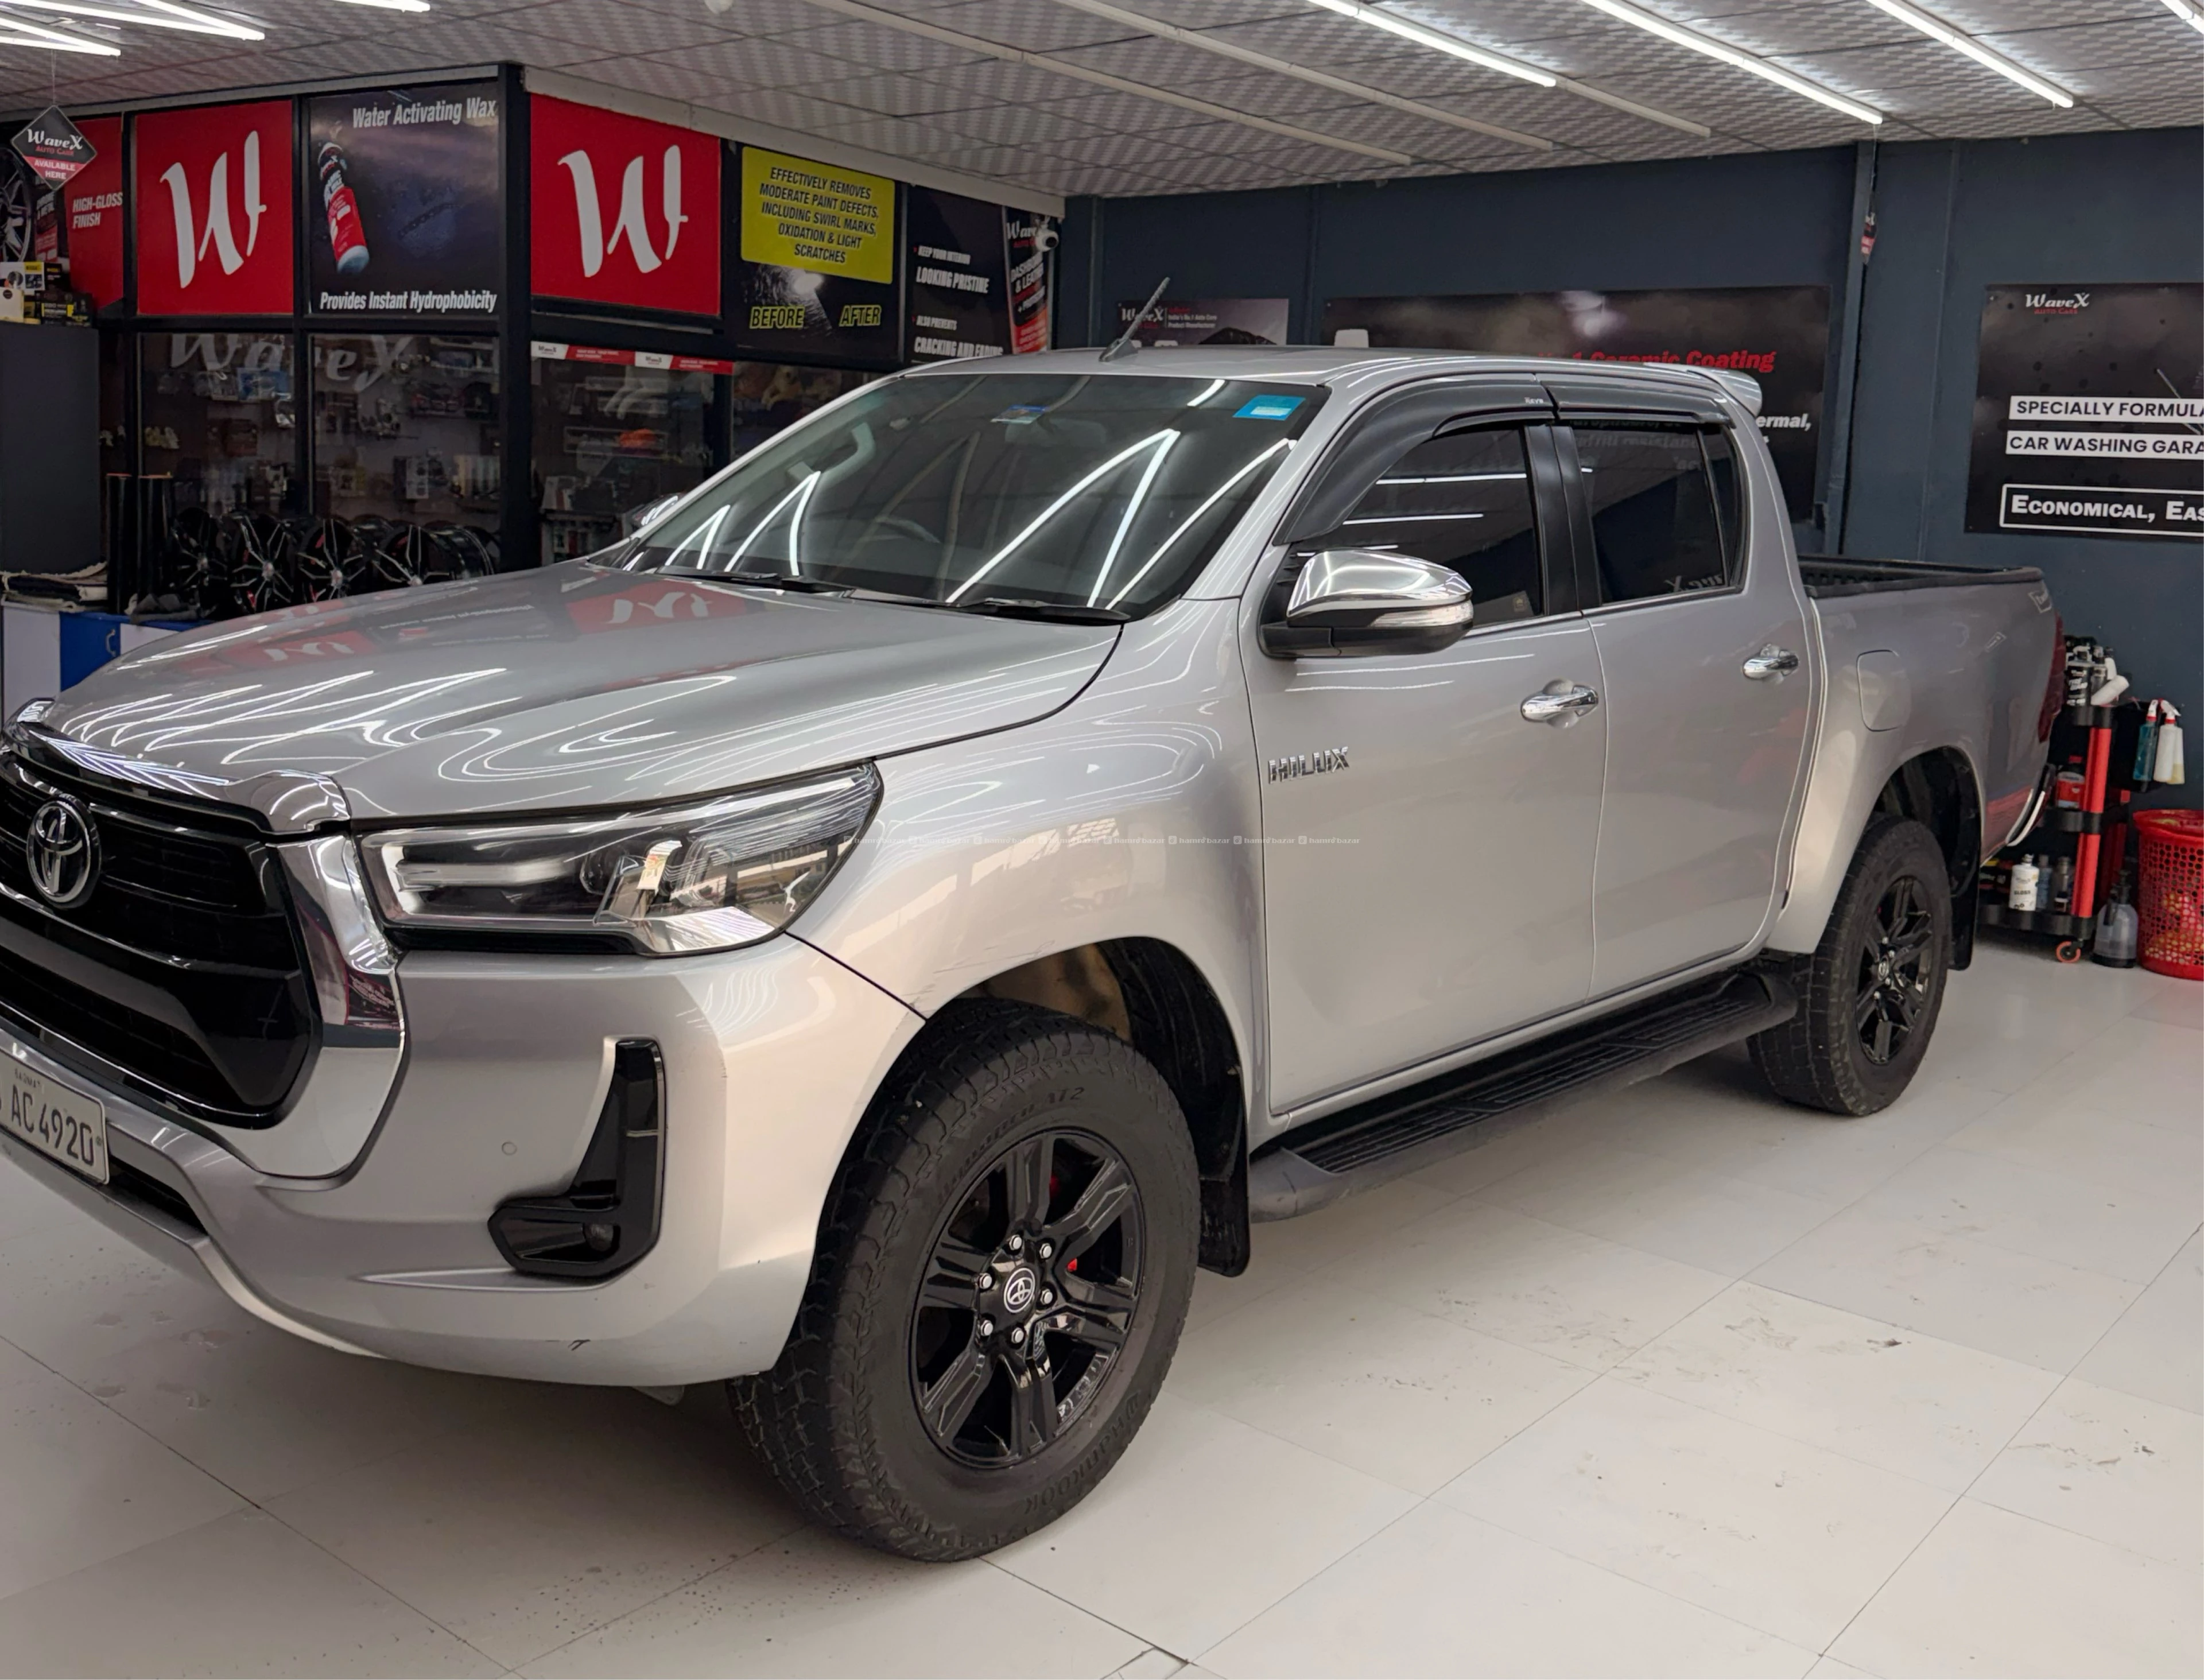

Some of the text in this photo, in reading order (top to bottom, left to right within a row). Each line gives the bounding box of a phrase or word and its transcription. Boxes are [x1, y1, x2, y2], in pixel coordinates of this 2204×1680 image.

[353, 96, 496, 129] Water Activating Wax
[27, 129, 83, 150] WaveX
[34, 159, 75, 172] AVAILABLE
[45, 170, 67, 180] HERE
[770, 167, 871, 200] EFFECTIVELY REMOVES
[73, 191, 123, 213] HIGH-GLOSS
[759, 183, 879, 219] MODERATE PAINT DEFECTS,
[73, 213, 100, 230] FINISH
[762, 202, 876, 237] INCLUDING SWIRL MARKS,
[778, 223, 862, 249] OXIDATION & LIGHT
[794, 244, 846, 263] SCRATCHES
[916, 266, 990, 294] LOOKING PRISTINE
[320, 290, 498, 313] Provides Instant Hydrophobicity
[2025, 292, 2090, 309] WaveX
[750, 305, 804, 329] BEFORE
[839, 305, 882, 327] AFTER
[1122, 307, 1164, 322] WeX
[914, 336, 957, 356] CRACKING
[1686, 350, 1776, 373] Coating
[2017, 401, 2114, 416] SPECIALLY
[1755, 413, 1811, 432] ermal,
[2010, 436, 2204, 455] CAR WASHING GARA
[1268, 746, 1349, 784] HILUX
[39, 1103, 94, 1167] 4920
